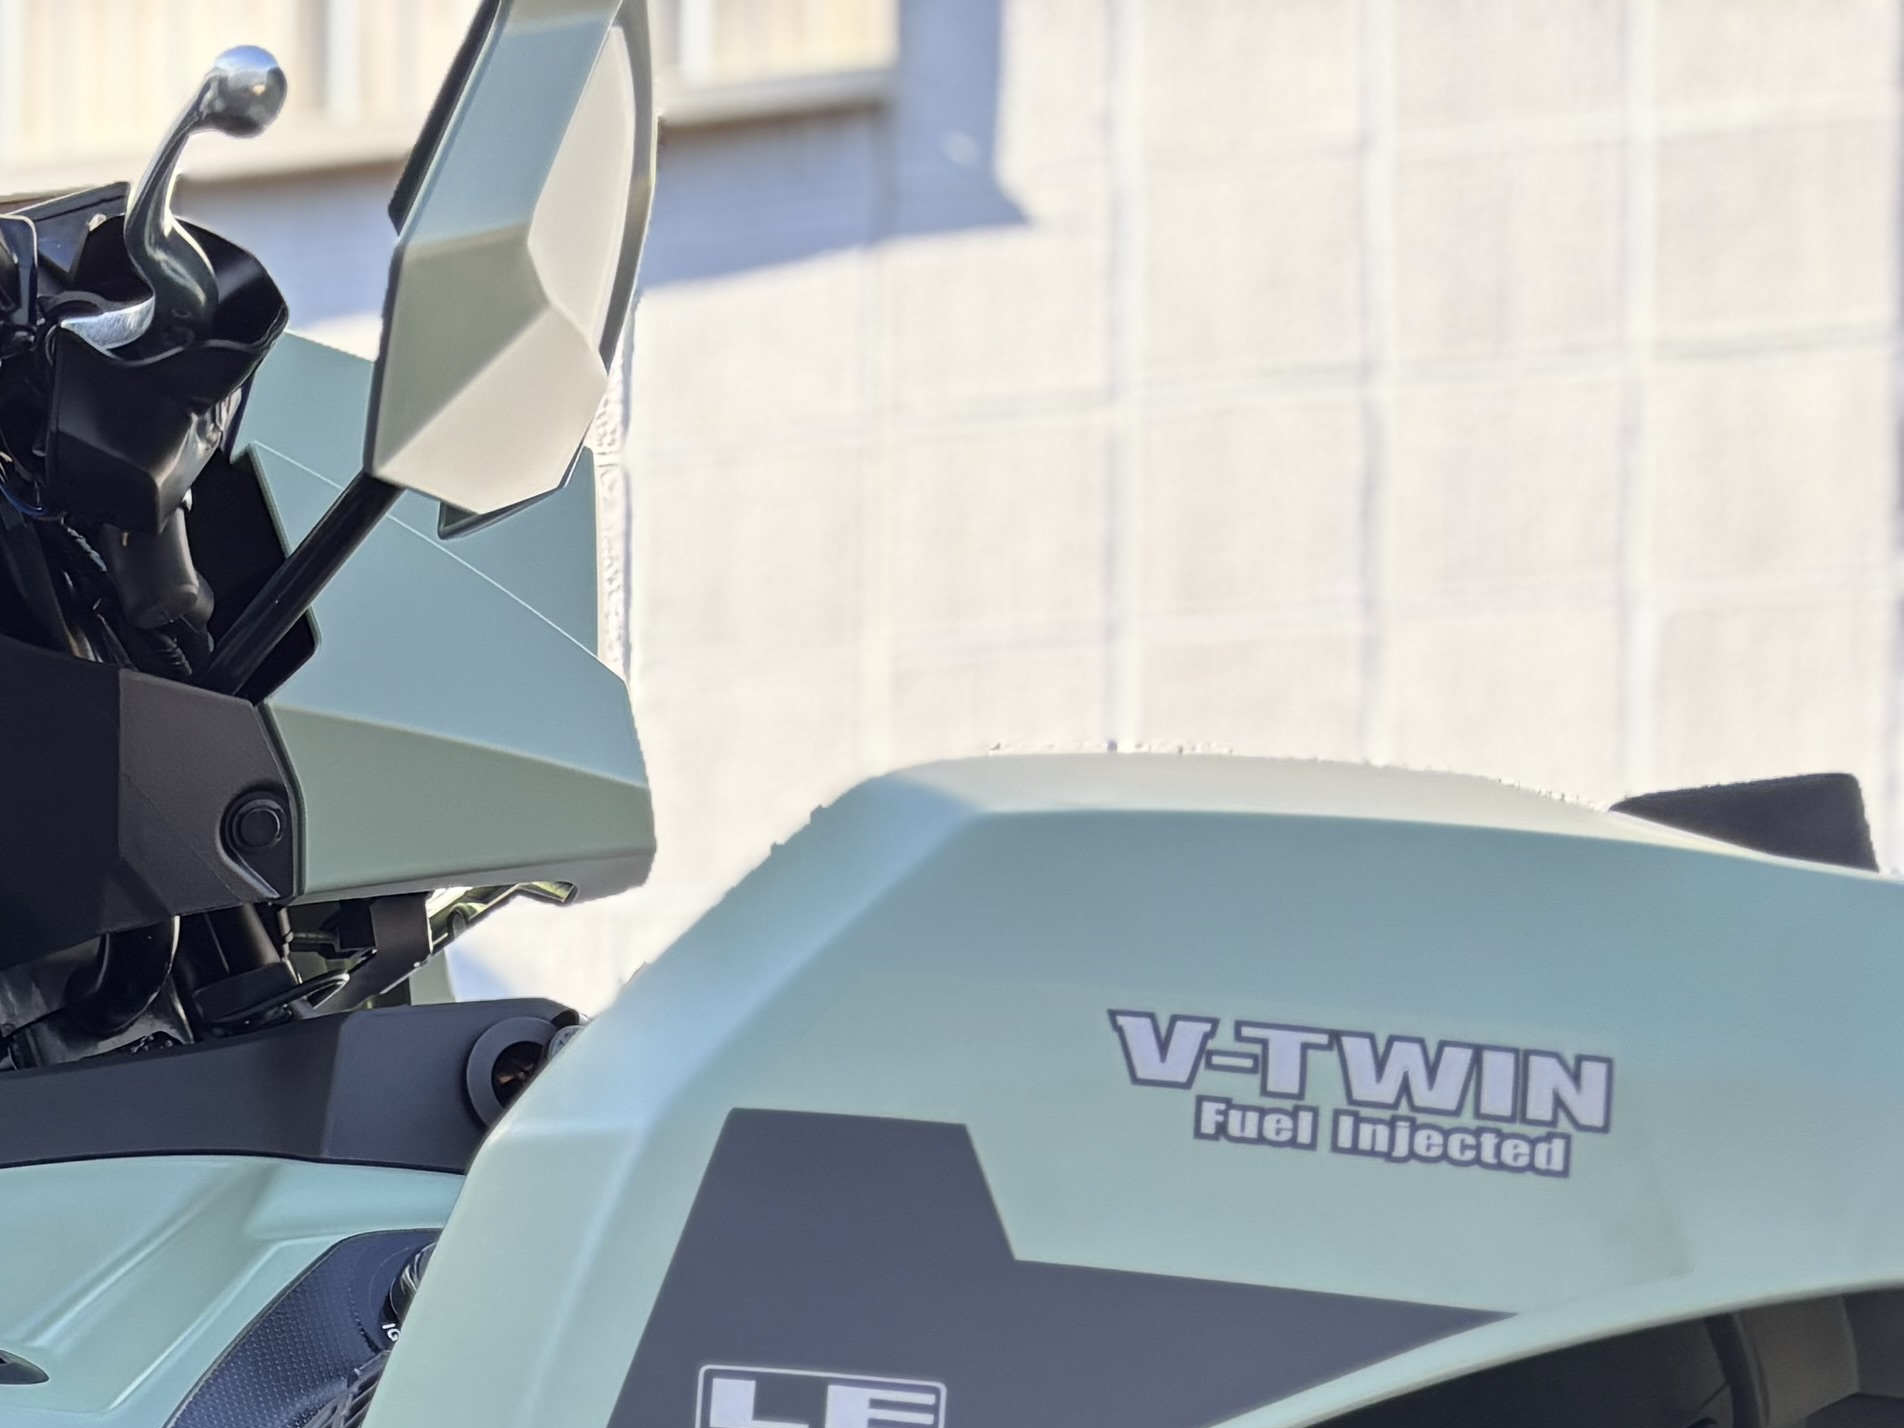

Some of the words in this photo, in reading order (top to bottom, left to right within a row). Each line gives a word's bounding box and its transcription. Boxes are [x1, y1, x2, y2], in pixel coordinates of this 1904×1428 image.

[1107, 1008, 1614, 1133] V-TWIN
[1193, 1095, 1319, 1150] Fuel
[1330, 1107, 1571, 1178] Injected
